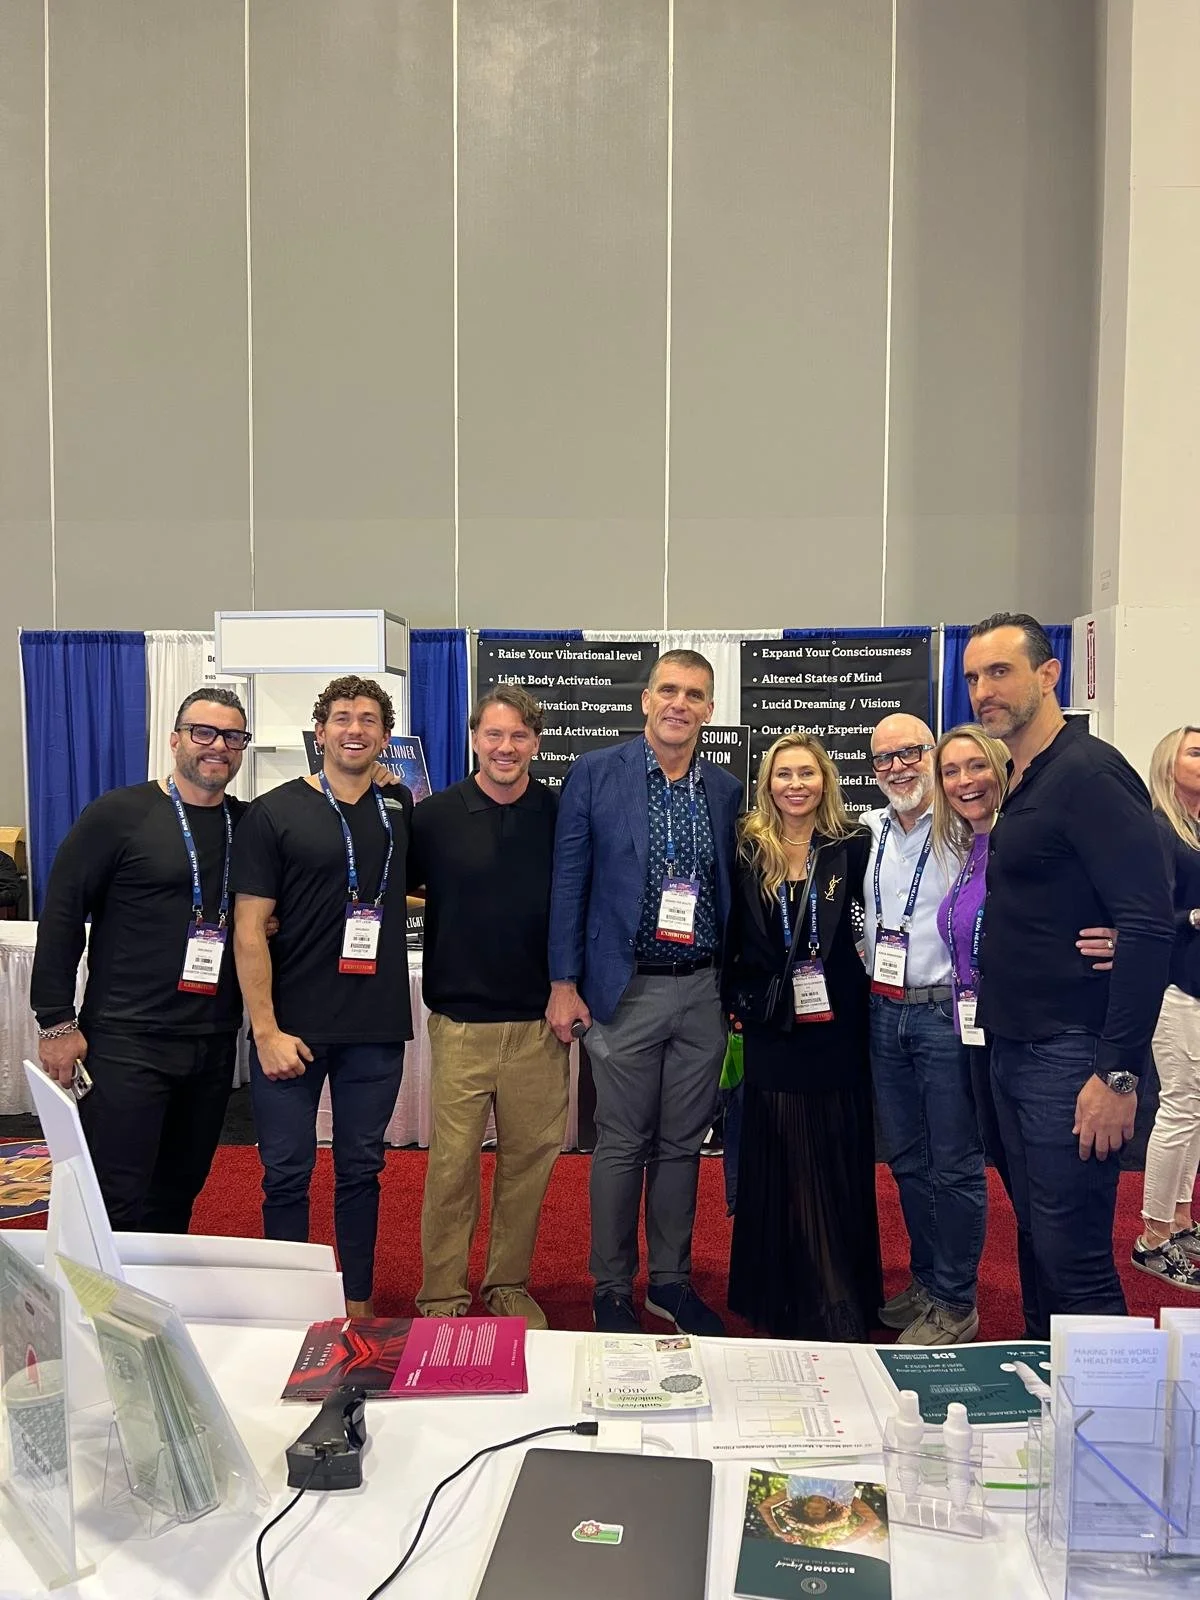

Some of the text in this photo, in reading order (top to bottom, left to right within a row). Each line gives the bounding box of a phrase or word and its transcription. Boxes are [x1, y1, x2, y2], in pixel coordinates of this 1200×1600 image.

[497, 649, 642, 661] Raise Your Vibrational level
[761, 646, 912, 660] Expand Your Consciousness
[497, 674, 612, 687] Light Body Activation
[761, 672, 882, 684] Altered States of Mind
[536, 700, 633, 713] tivation Programs
[761, 698, 900, 711] Lucid Dreaming / Visions
[540, 726, 619, 737] and Activation
[761, 724, 875, 737] Out of Body Experien
[701, 731, 742, 746] SOUND,
[387, 744, 417, 760] INNER
[827, 749, 867, 760] Visuals
[844, 801, 872, 812] tions
[907, 873, 921, 906] RUPA HEALTH
[973, 917, 983, 955] RUPA HEALTH
[1073, 1347, 1159, 1356] MAKING THE WORLD
[804, 1565, 855, 1574] BIOSOMO
